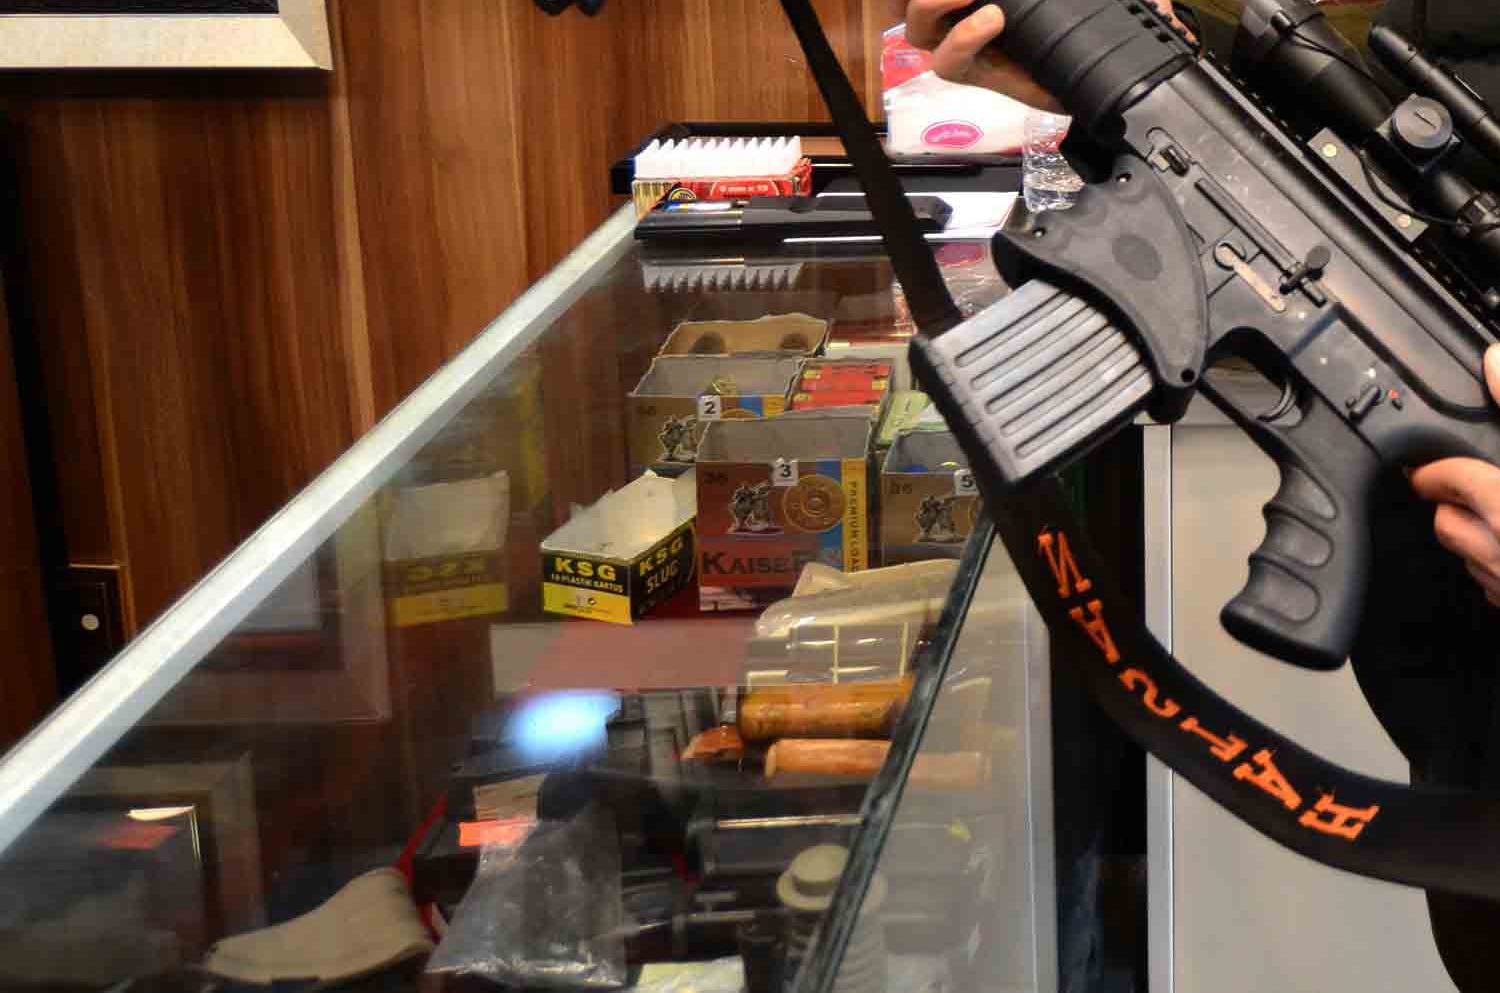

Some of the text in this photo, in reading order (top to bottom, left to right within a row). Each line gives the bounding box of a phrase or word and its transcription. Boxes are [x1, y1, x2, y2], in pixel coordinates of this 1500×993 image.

[703, 400, 716, 415] 2
[781, 464, 792, 478] 3
[961, 474, 973, 488] 5
[554, 556, 618, 582] KSG
